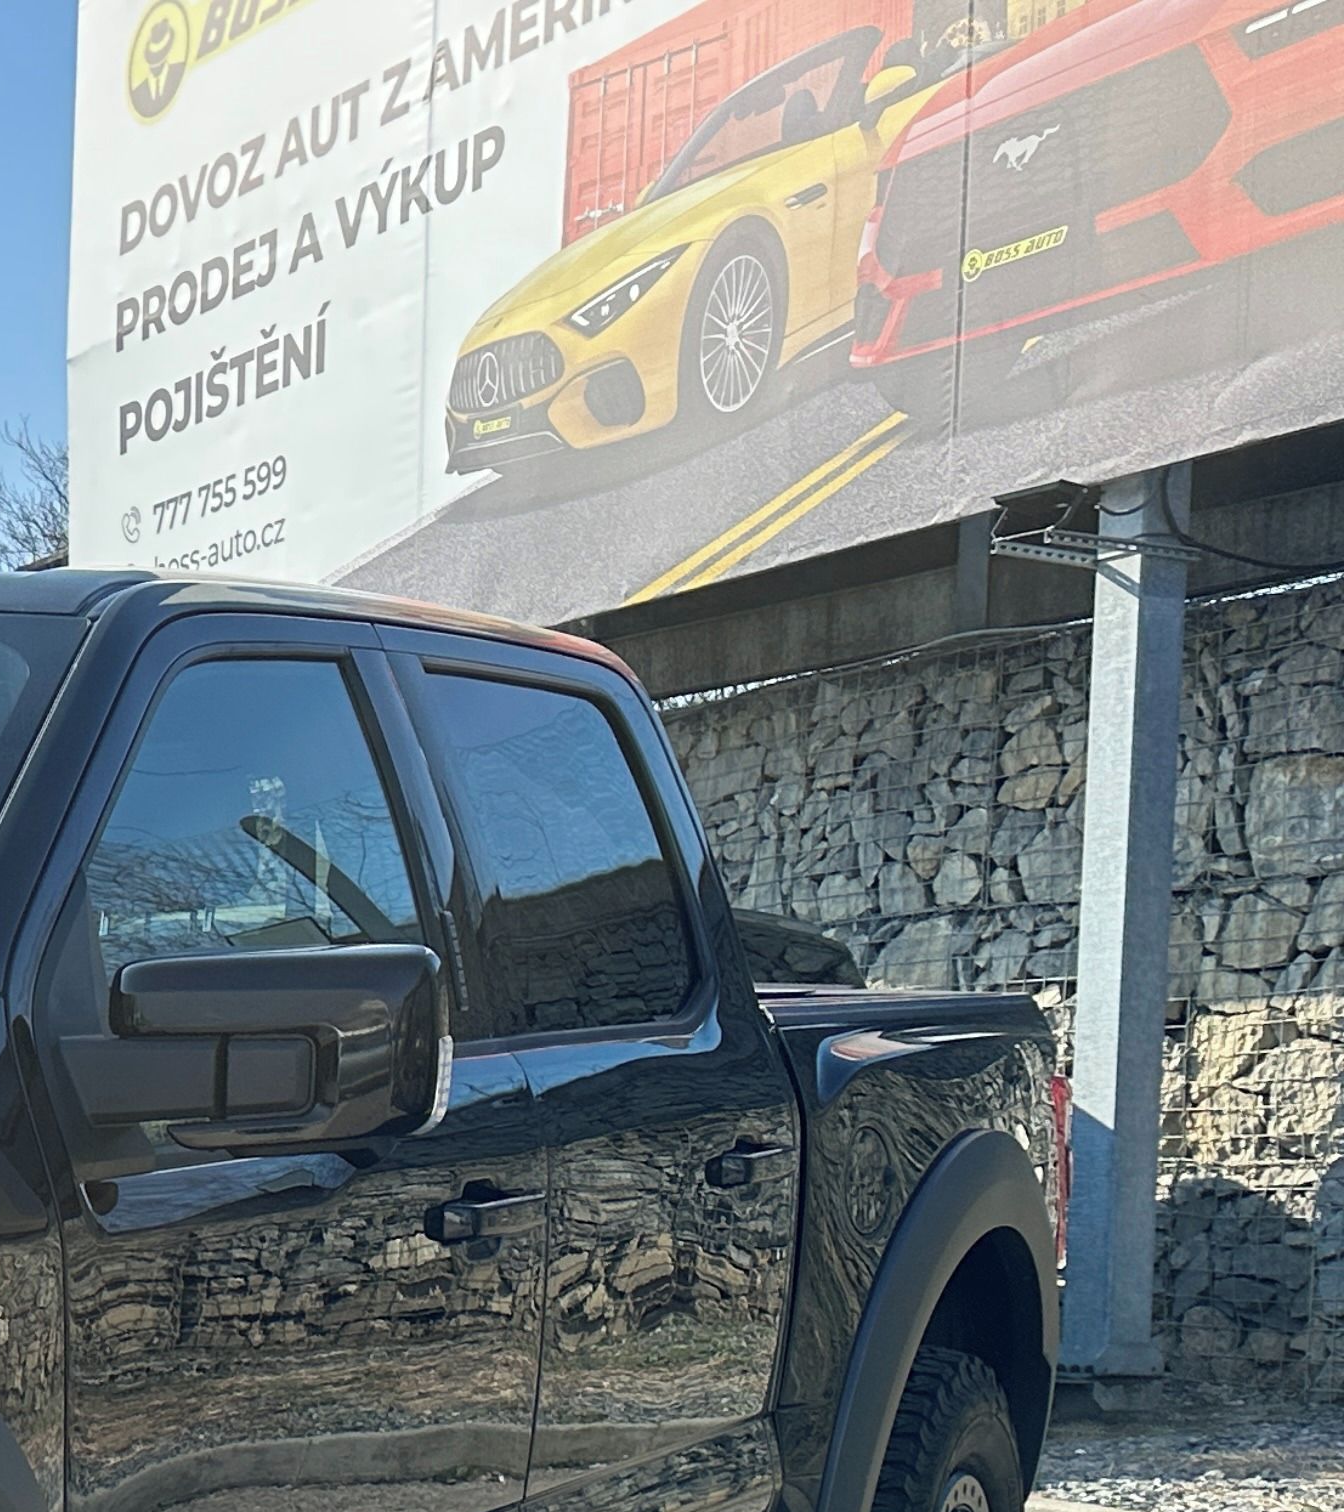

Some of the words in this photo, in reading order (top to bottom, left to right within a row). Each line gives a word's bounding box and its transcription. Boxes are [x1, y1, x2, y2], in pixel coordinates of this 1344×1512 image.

[119, 133, 266, 256] DOVOZ
[275, 79, 369, 178] AUT
[380, 58, 412, 127] Z
[423, 0, 633, 101] AMER
[116, 229, 278, 353] PRODEJ
[288, 212, 323, 275] A
[335, 125, 506, 249] VÝKUP
[119, 301, 331, 456] POJIŠTĚNÍ
[153, 491, 192, 535] 777
[198, 474, 236, 517] 755
[242, 455, 287, 501] 599
